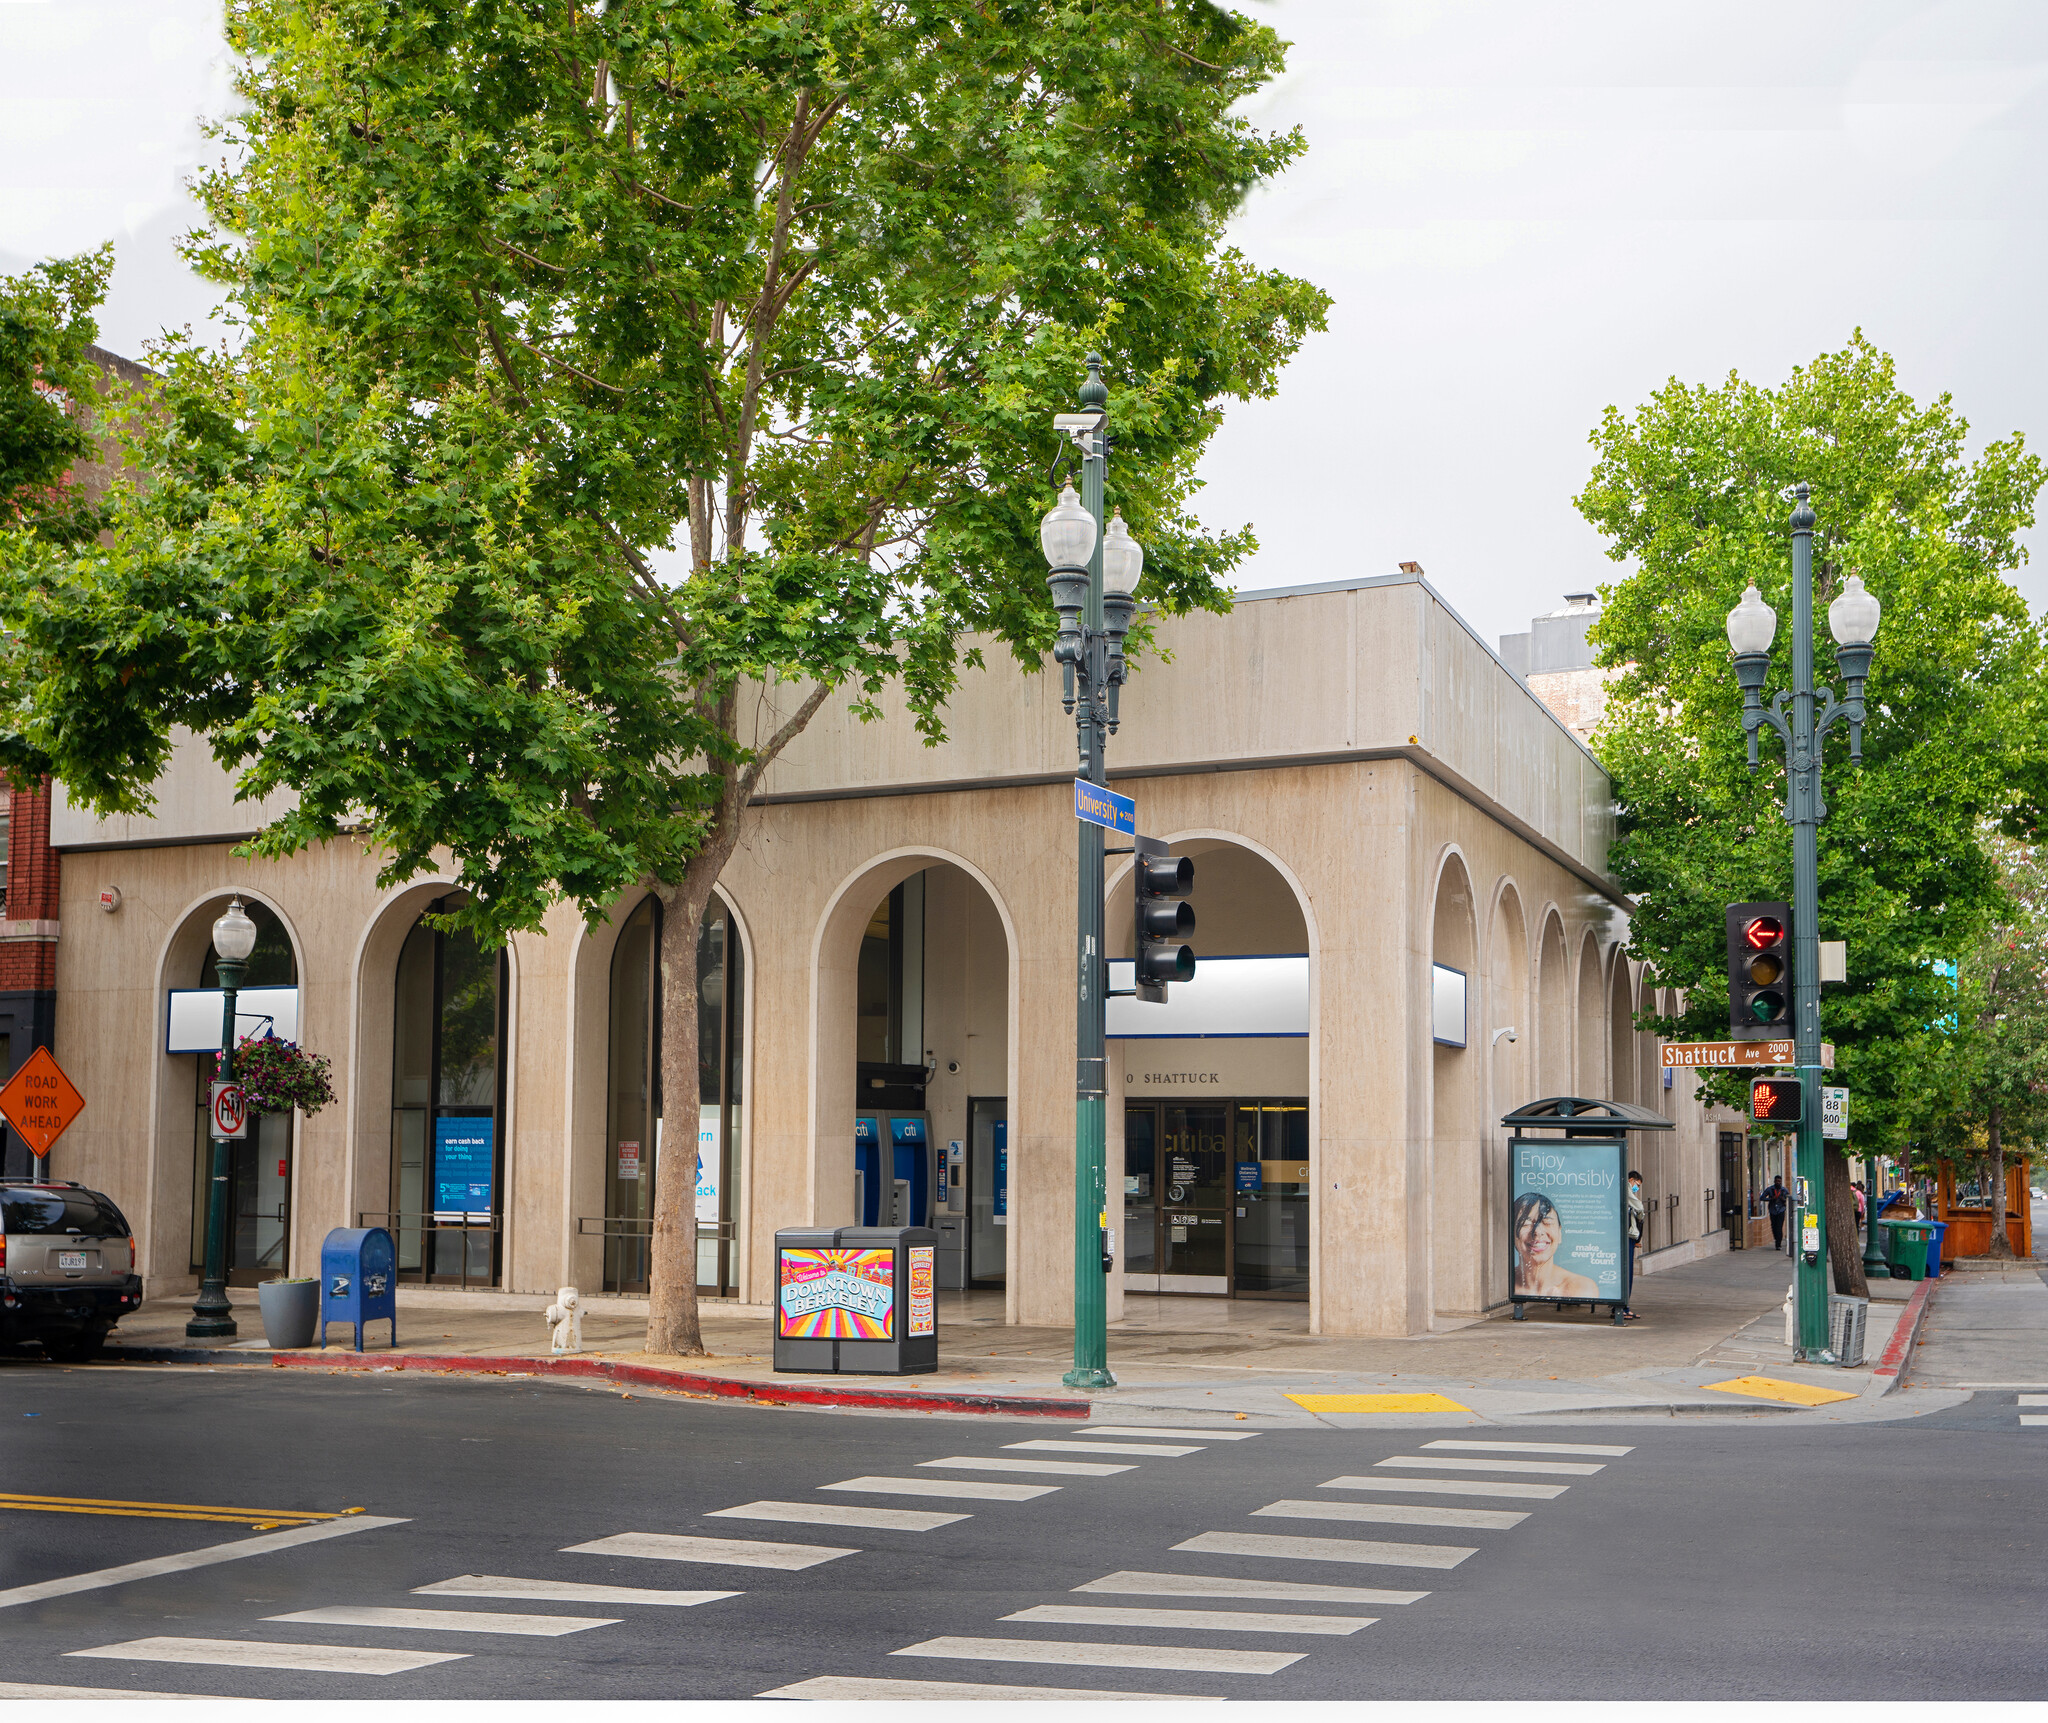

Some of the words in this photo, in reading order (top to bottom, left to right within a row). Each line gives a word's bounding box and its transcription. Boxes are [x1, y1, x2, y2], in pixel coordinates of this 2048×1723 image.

[1078, 788, 1118, 827] University
[1666, 1046, 1736, 1065] Shattuck
[1746, 1049, 1759, 1058] Ave
[1768, 1043, 1789, 1053] 2000
[25, 1076, 57, 1088] ROAD
[1144, 1073, 1219, 1083] SHATTUCK
[25, 1096, 58, 1108] WORK
[1826, 1101, 1839, 1110] 88
[21, 1116, 61, 1128] AHEAD
[1823, 1114, 1839, 1123] 800
[856, 1123, 869, 1136] citi
[904, 1124, 917, 1136] citi
[1165, 1128, 1256, 1153] citibak
[1521, 1151, 1565, 1171] Enjoy
[1521, 1169, 1615, 1190] responsibly
[1571, 1251, 1595, 1260] every
[1596, 1250, 1617, 1260] drop
[796, 1271, 819, 1282] Welcome
[787, 1277, 886, 1303] DOWNTOWN
[795, 1291, 879, 1314] BERKELEY
